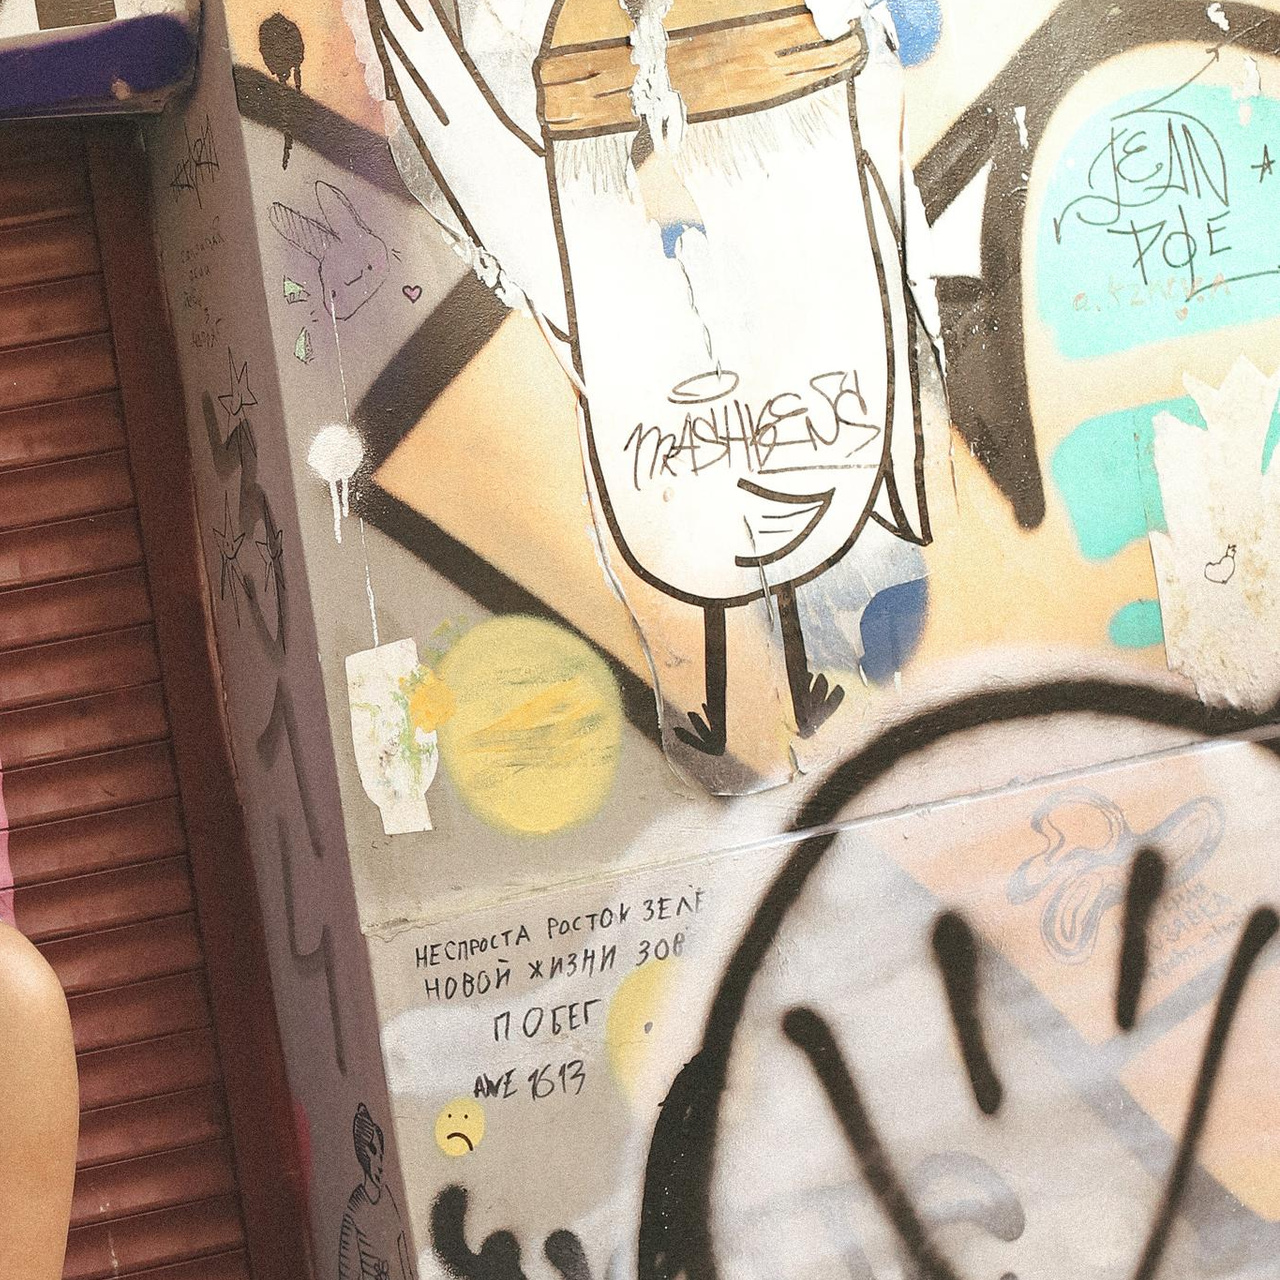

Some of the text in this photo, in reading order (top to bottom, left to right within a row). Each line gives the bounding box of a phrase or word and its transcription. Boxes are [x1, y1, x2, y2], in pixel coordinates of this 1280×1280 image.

[415, 924, 531, 969] НЕСПРОСТА
[547, 903, 631, 939] РОСТОК
[424, 959, 511, 1001] НОВОЙ
[528, 944, 617, 980] ЖИЗНИ
[493, 999, 602, 1042] ПОБЕГ
